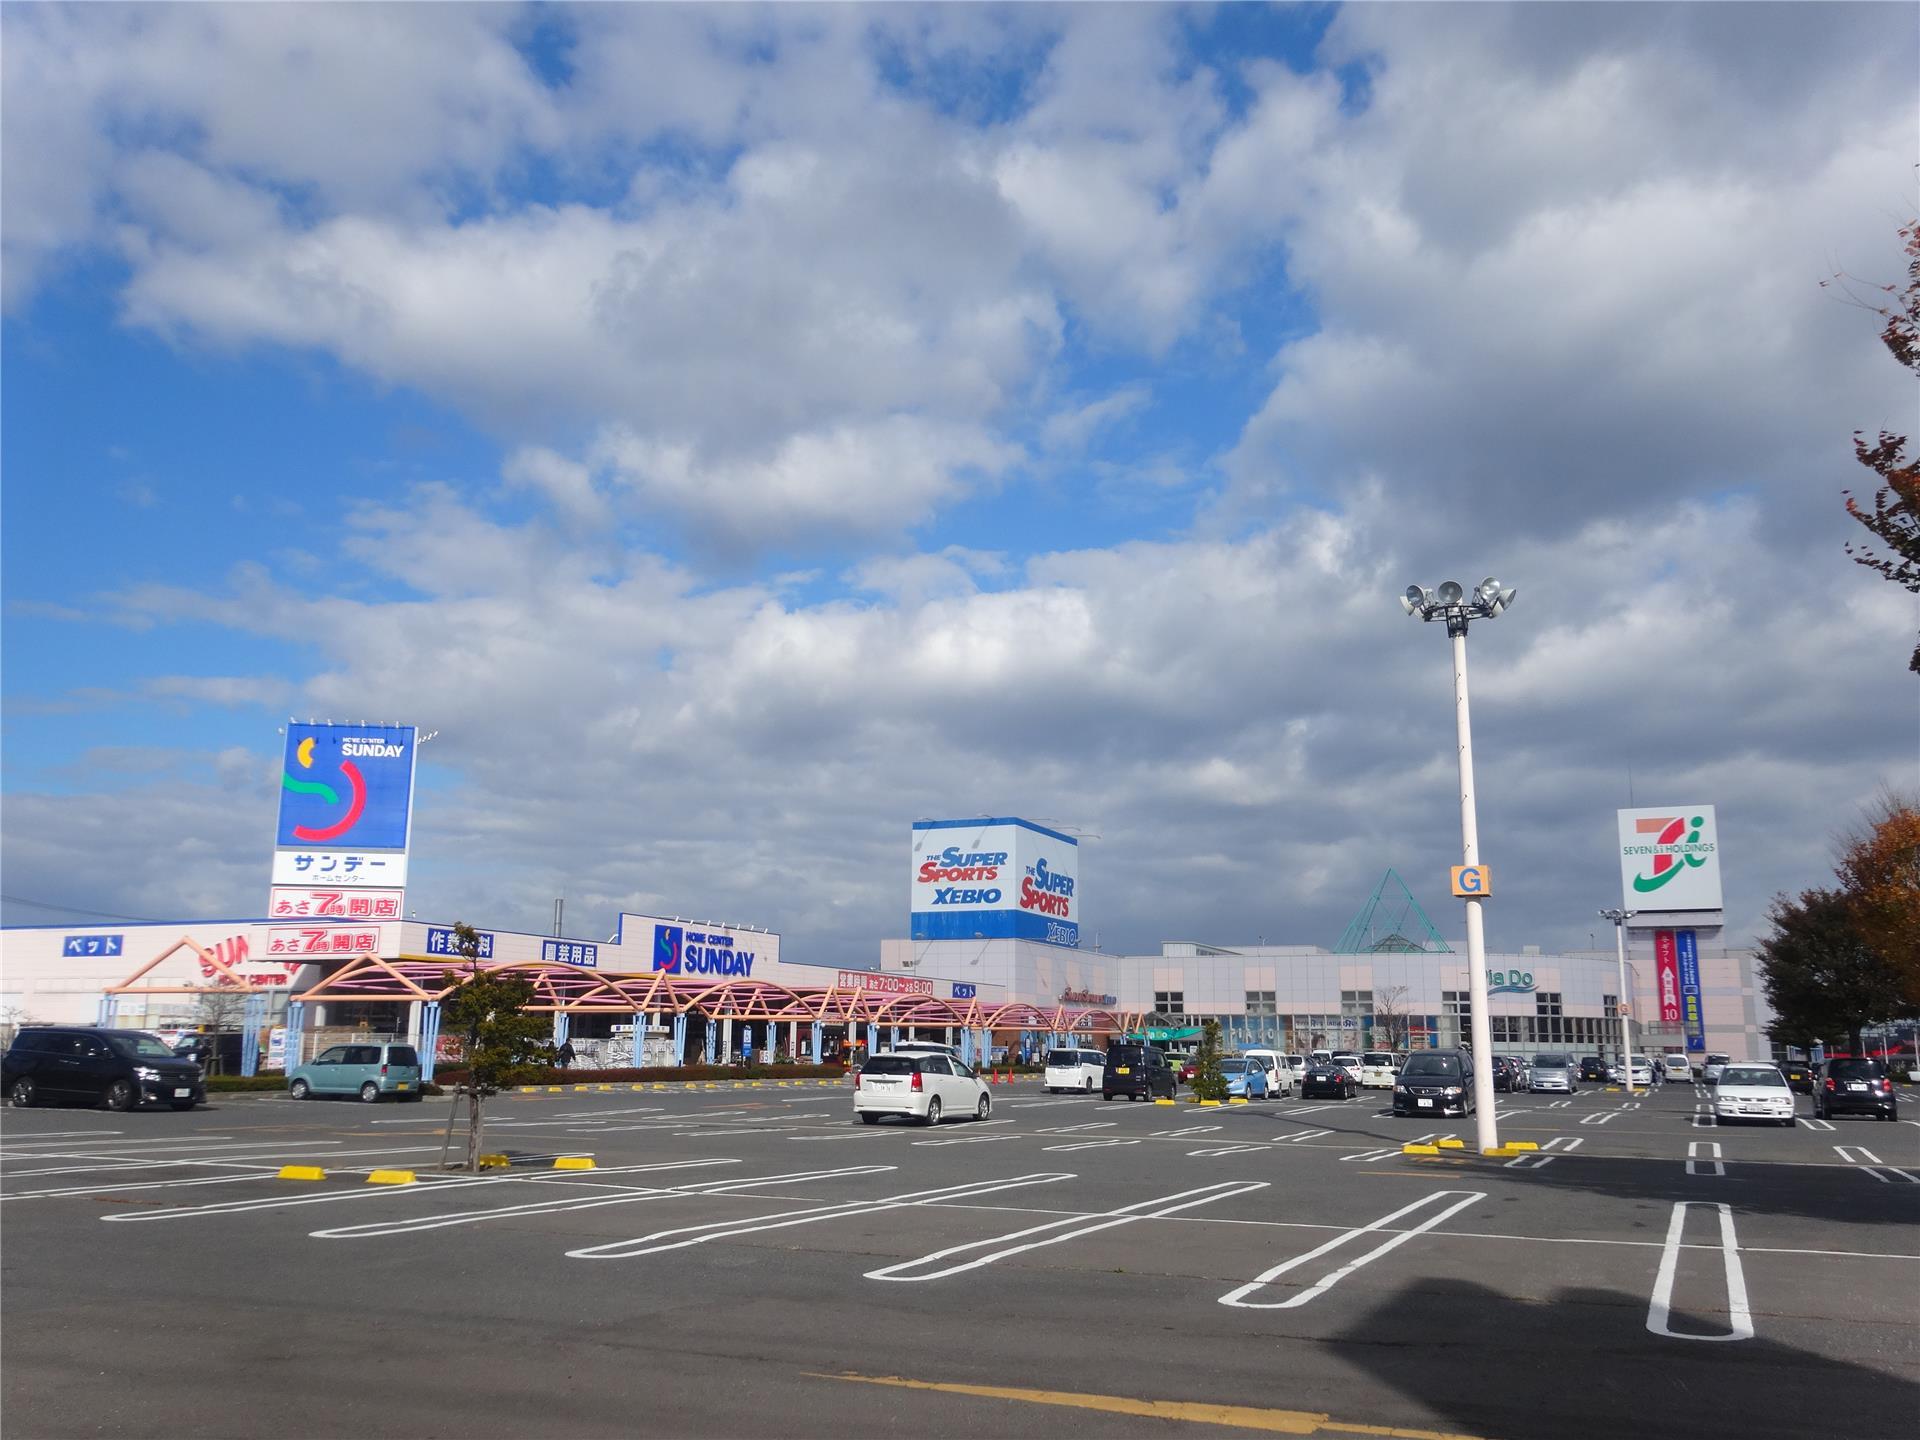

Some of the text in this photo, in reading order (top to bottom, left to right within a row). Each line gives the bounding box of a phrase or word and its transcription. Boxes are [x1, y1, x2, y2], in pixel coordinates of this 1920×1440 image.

[342, 743, 404, 758] SUNDAY
[294, 855, 386, 872] サンデー
[939, 847, 1008, 867] SUPER
[312, 874, 365, 882] ホームセンター
[917, 862, 998, 883] SPORTS
[1025, 858, 1075, 897] THE SUPER
[1459, 868, 1482, 892] G
[931, 886, 1002, 905] XEBIO
[1019, 876, 1070, 918] SPORTS
[685, 931, 734, 948] HOME CENTER
[1045, 921, 1078, 946] XEBIO
[68, 937, 117, 954] ペット
[431, 931, 491, 956] 作業料
[684, 944, 755, 977] SUNDAY
[1486, 969, 1533, 986] ia Do
[1664, 1009, 1678, 1020] 10
